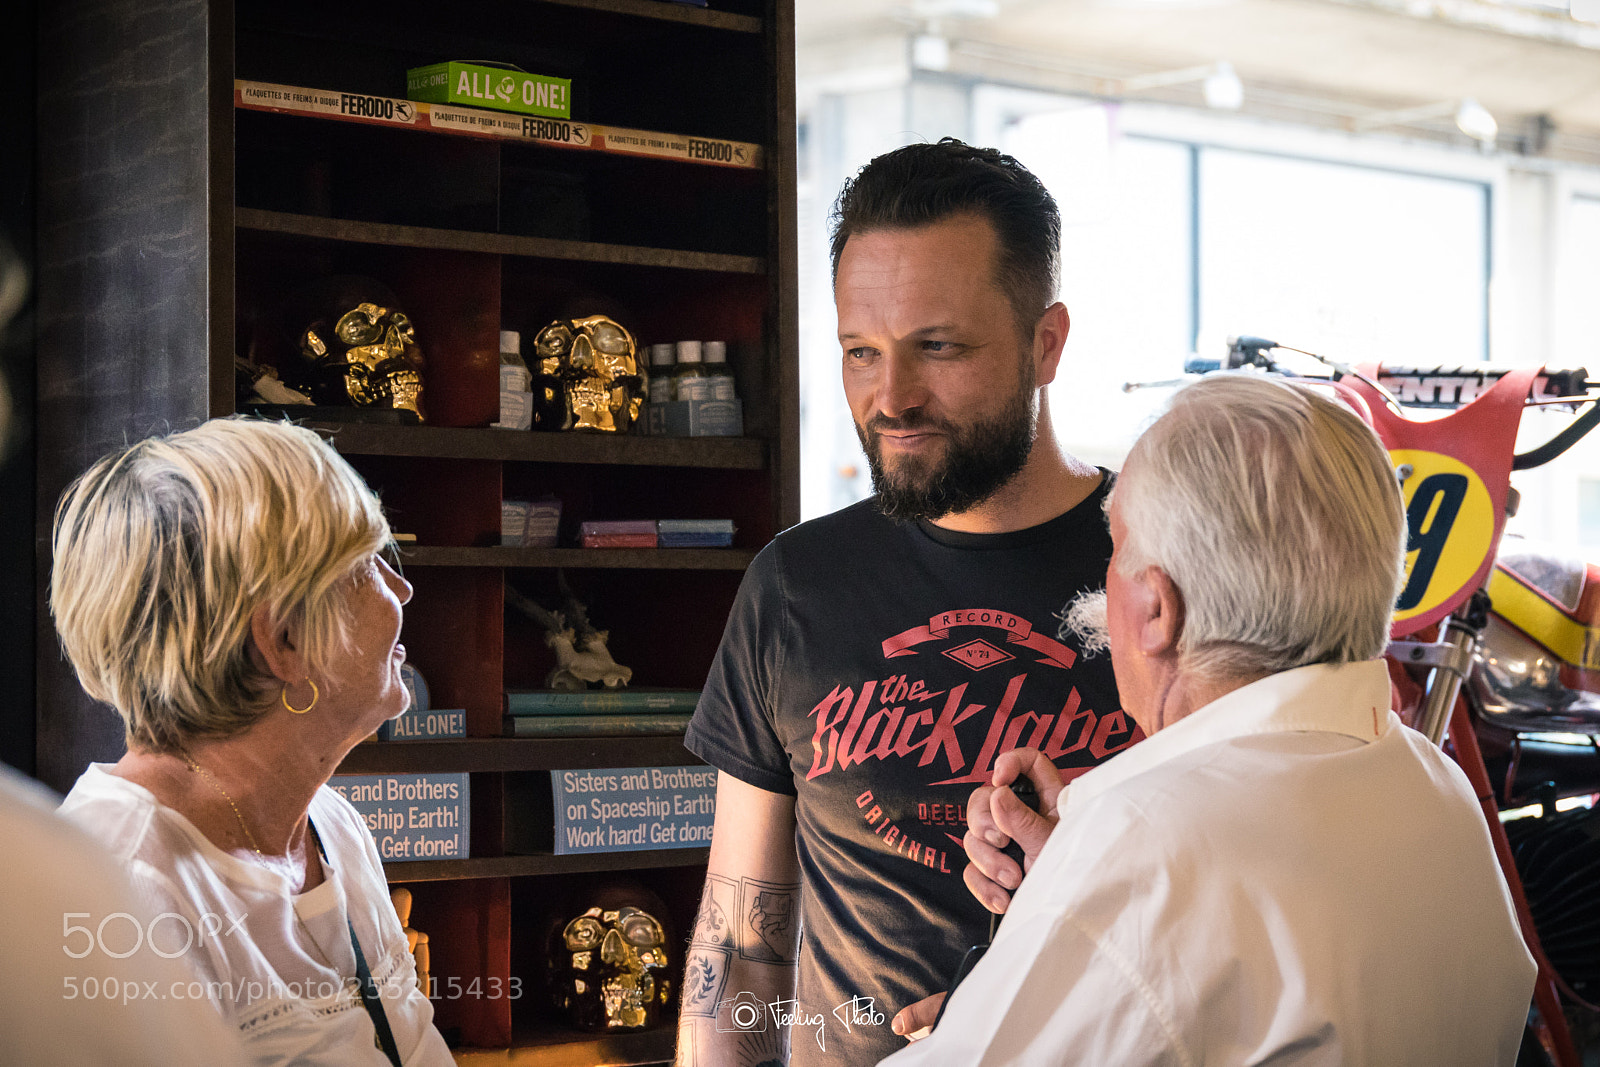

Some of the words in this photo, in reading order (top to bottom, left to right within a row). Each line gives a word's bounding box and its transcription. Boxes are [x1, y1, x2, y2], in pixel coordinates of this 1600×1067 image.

[430, 73, 448, 87] ONE!
[456, 70, 495, 100] ALL
[522, 79, 566, 110] ONE!
[246, 87, 282, 100] PLAQUETTES
[283, 92, 291, 101] DE
[292, 93, 312, 103] FREINS
[320, 97, 339, 107] DISQUE
[341, 94, 393, 119] FERODO
[434, 112, 468, 124] PLAQUETTES
[522, 118, 570, 141] FERODO
[608, 134, 638, 145] PLAQUETTES
[688, 139, 732, 162] FERODO
[1396, 473, 1468, 611] 9
[942, 610, 1017, 629] RECORD
[880, 674, 946, 705] the
[394, 713, 464, 737] ALL-ONE!
[806, 680, 987, 782] Black
[927, 673, 1148, 786] Labe
[350, 779, 383, 802] and
[387, 778, 459, 801] Brothers
[564, 771, 618, 794] Sisters
[621, 769, 649, 790] and
[653, 767, 717, 790] Brothers
[409, 805, 459, 828] Earth!
[567, 802, 587, 820] on
[590, 795, 670, 822] Spaceship
[918, 803, 968, 826] DEEL
[566, 824, 605, 848] Work
[608, 822, 647, 846] hard!
[650, 823, 676, 844] Get
[678, 820, 713, 842] done
[855, 790, 951, 874] ORIGINAL
[381, 835, 411, 859] Get
[414, 833, 459, 857] done!
